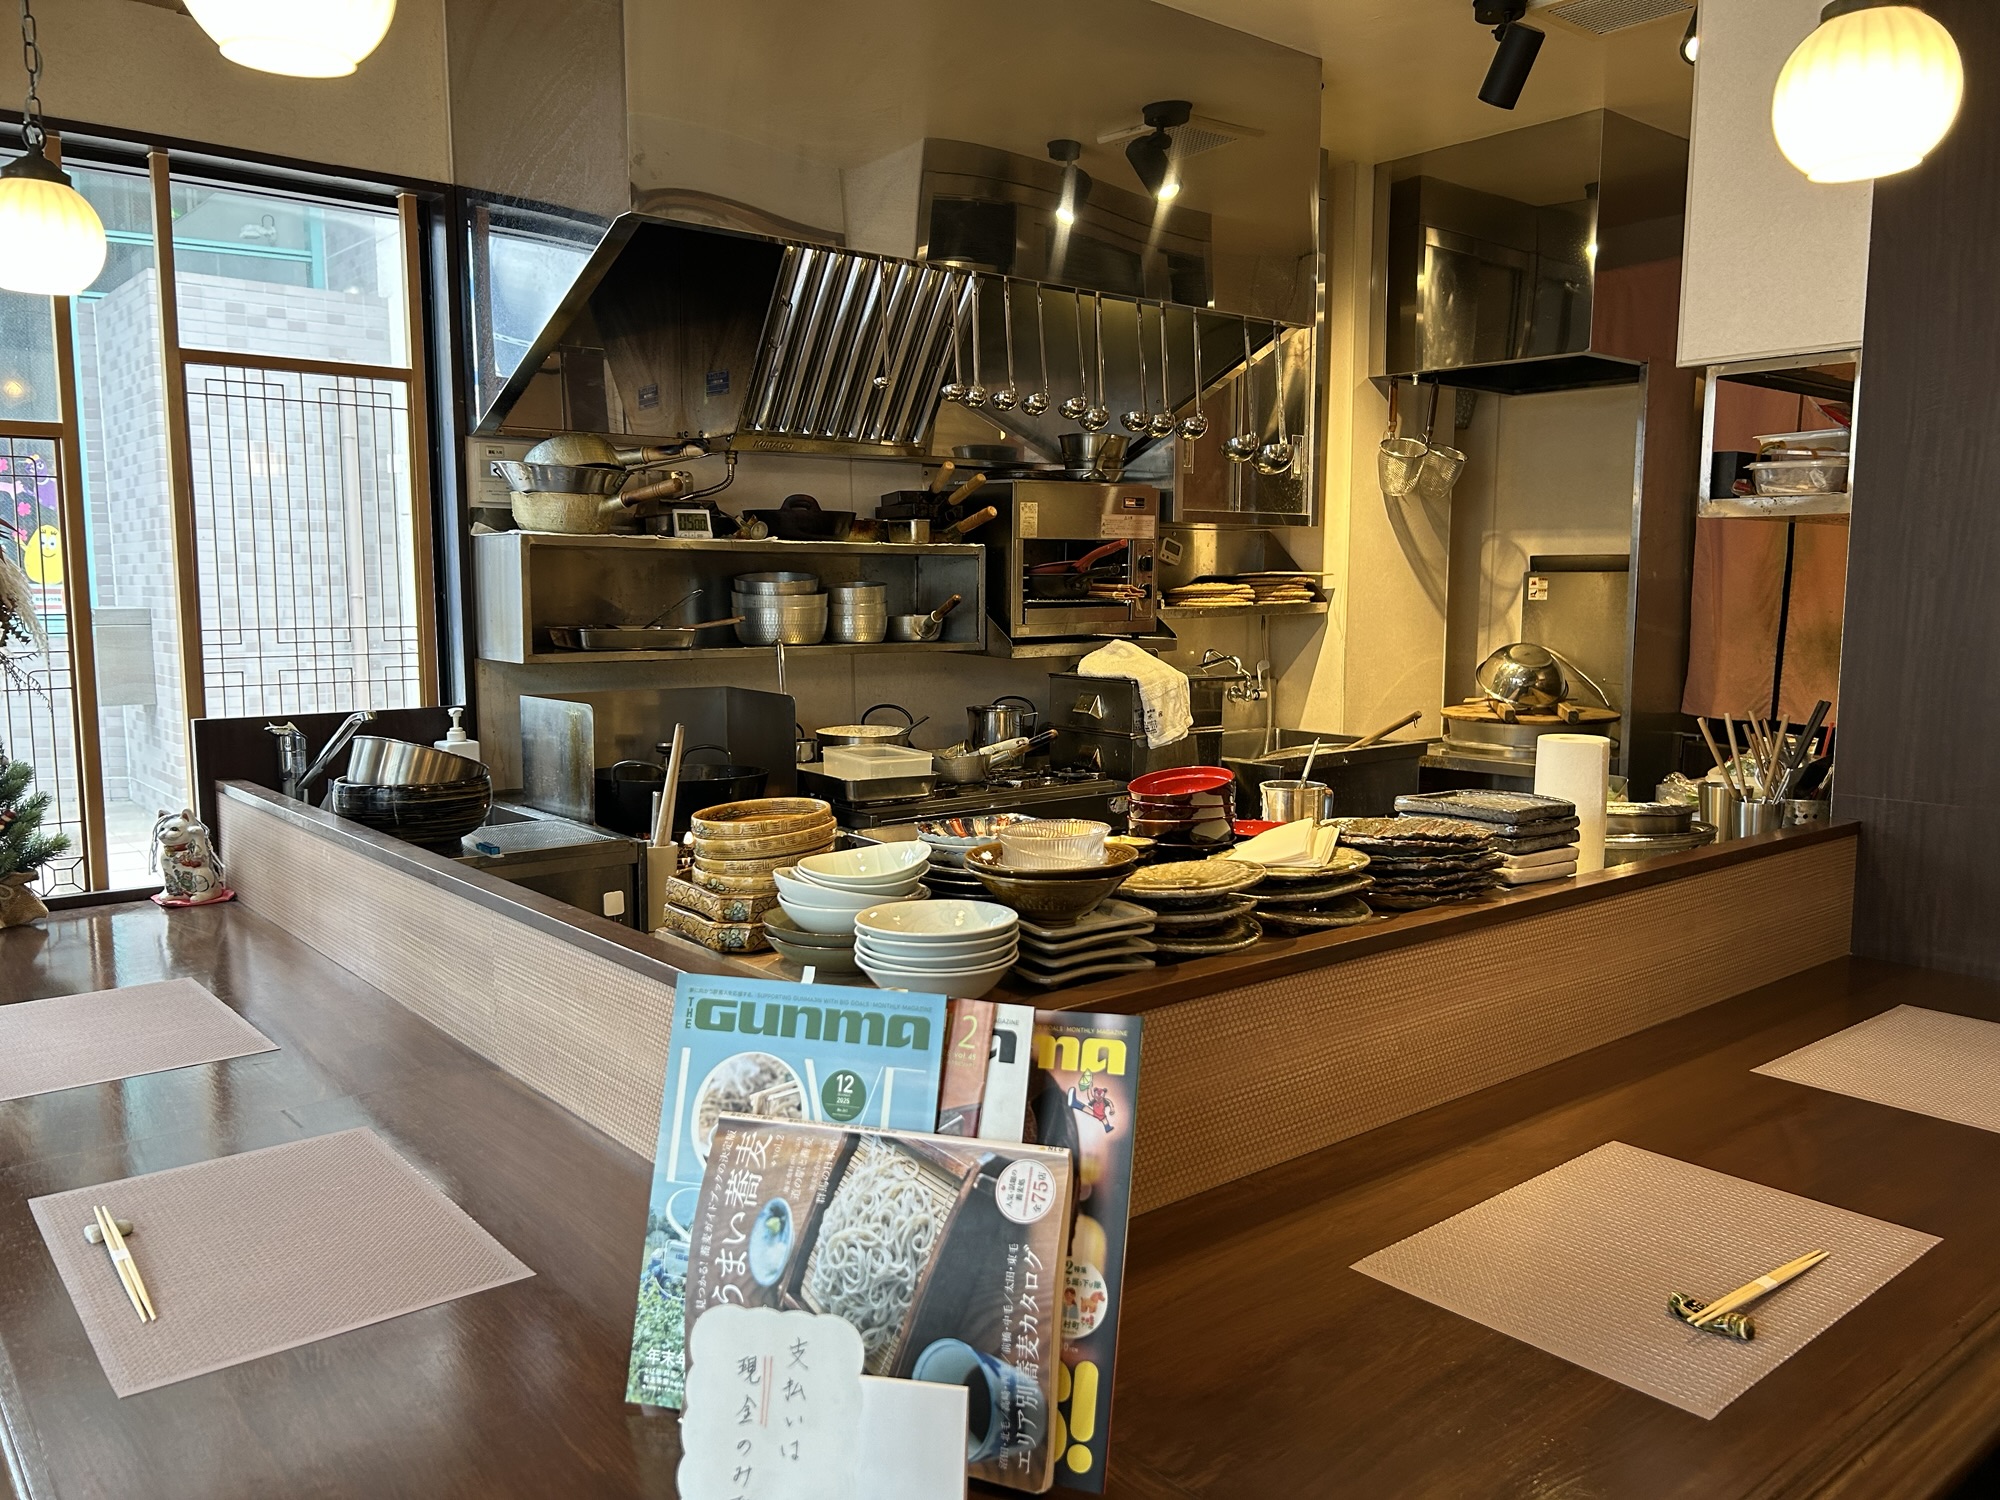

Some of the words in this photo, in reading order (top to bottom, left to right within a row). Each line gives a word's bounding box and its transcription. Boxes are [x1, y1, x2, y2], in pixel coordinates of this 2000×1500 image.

[685, 997, 694, 1029] THE
[902, 1004, 933, 1013] MAGAZINE
[1097, 1028, 1128, 1036] MAGAZINE
[836, 1074, 854, 1093] 12
[836, 1097, 850, 1105] 2025
[712, 1131, 773, 1303] うまい蕎麦
[1015, 1244, 1043, 1474] エリア別蕎麦カタログ
[780, 1337, 808, 1461] 支払いは
[730, 1355, 761, 1500] 現金のみ
